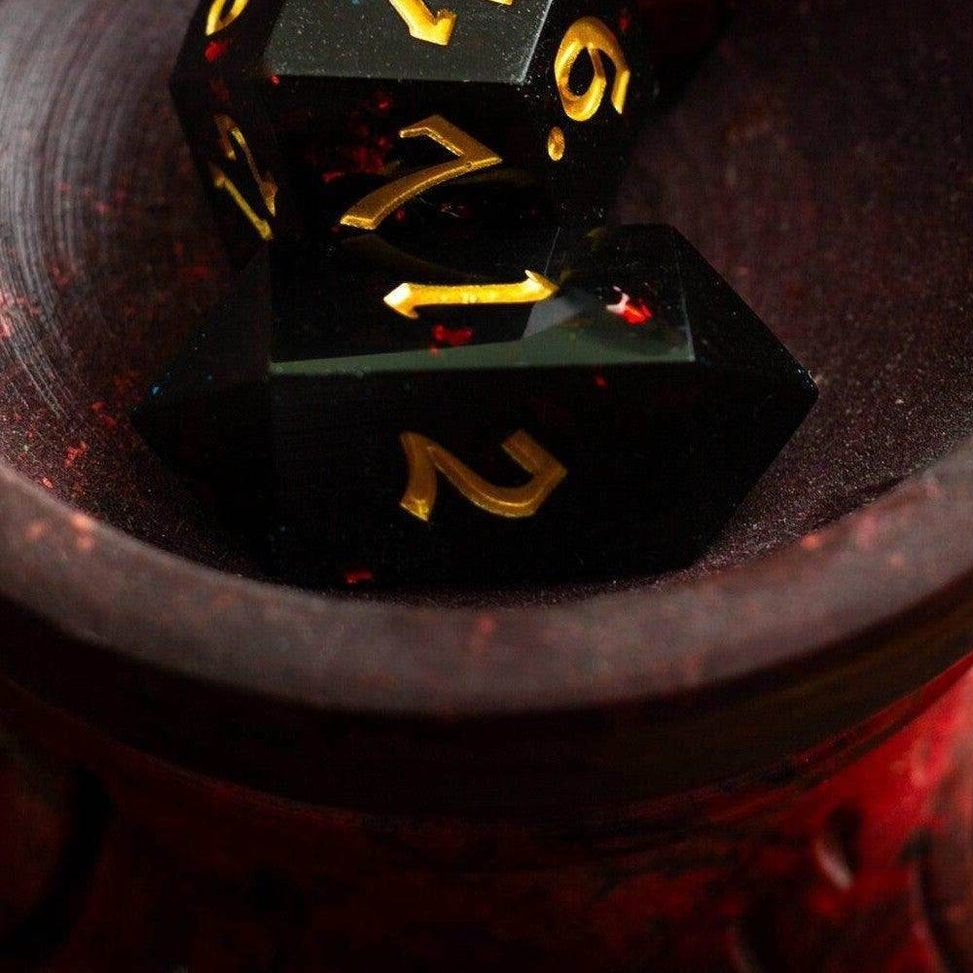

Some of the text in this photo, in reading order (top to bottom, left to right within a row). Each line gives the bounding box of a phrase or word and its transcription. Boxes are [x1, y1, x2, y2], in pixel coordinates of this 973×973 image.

[339, 113, 503, 231] 7
[383, 268, 560, 319] 1
[399, 428, 569, 523] 2
